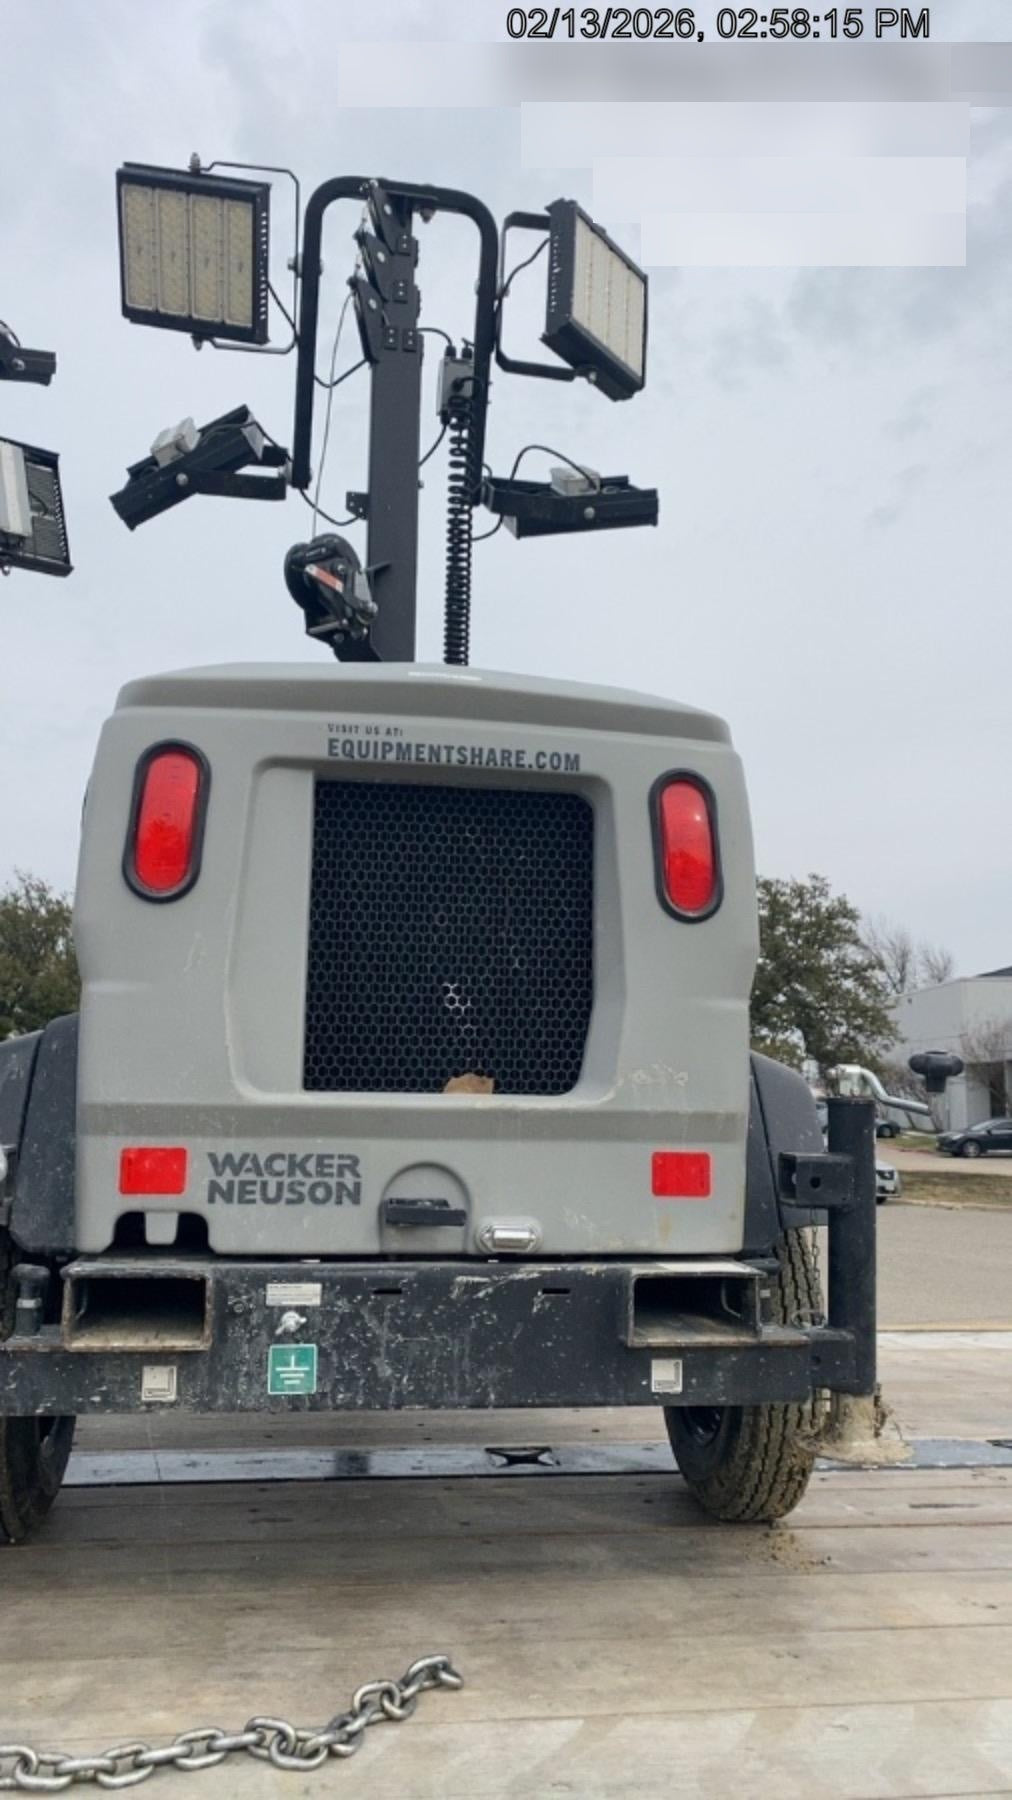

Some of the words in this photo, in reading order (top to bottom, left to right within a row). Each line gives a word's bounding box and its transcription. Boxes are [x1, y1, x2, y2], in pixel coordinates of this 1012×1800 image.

[327, 724, 359, 735] VISIT
[365, 725, 380, 735] US
[327, 738, 581, 772] EQUIPMENTSHARE.COM
[207, 1152, 362, 1179] WACKER
[207, 1180, 361, 1206] NEUSON
